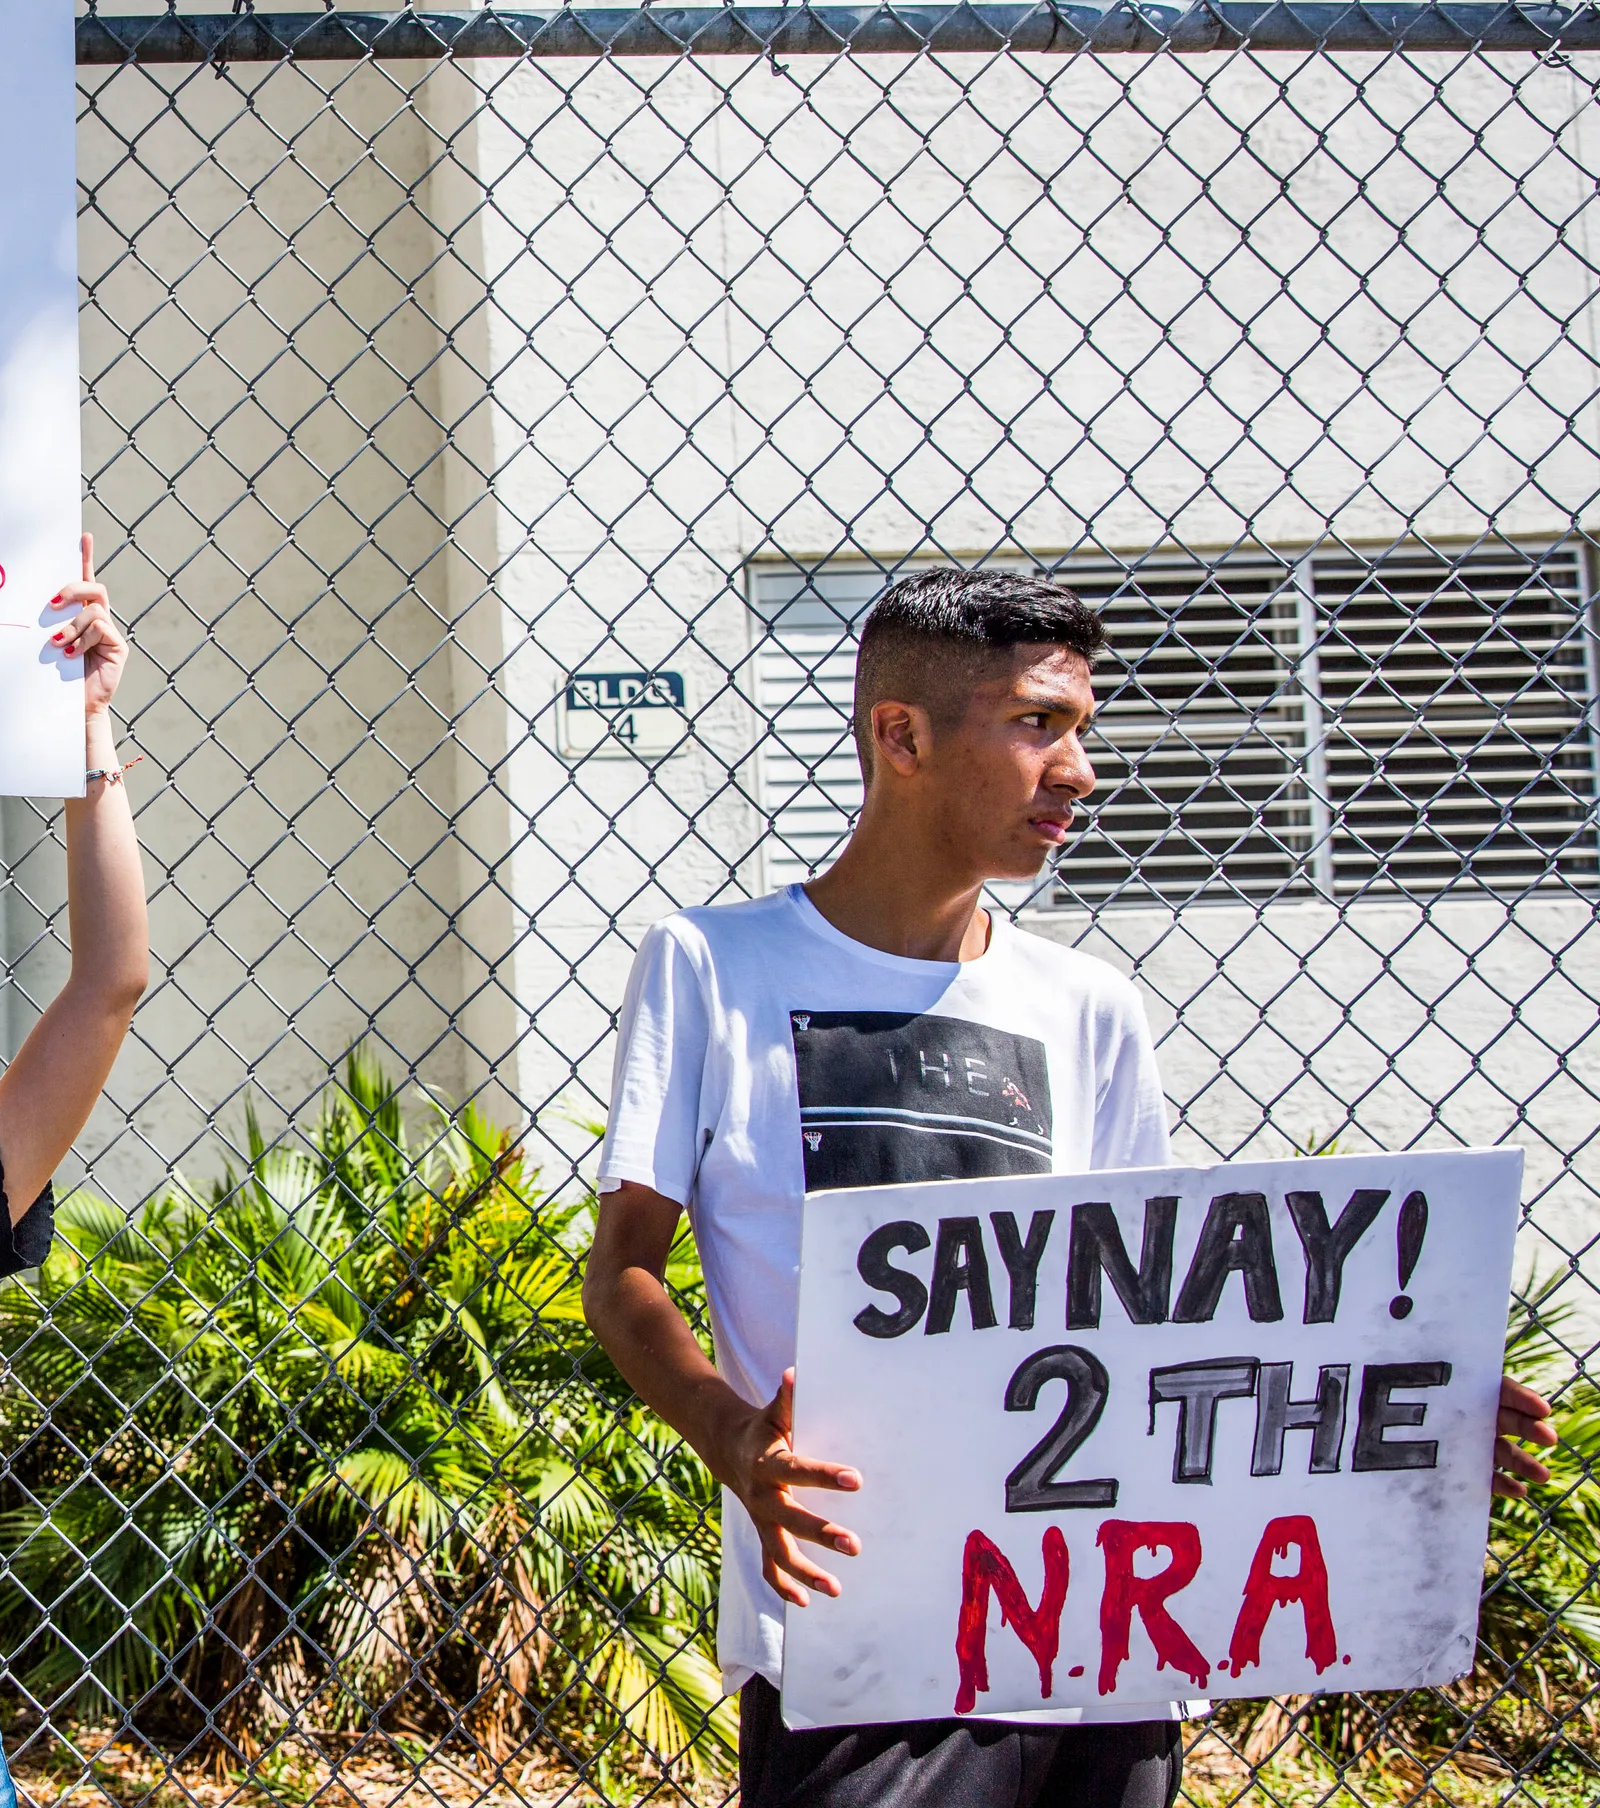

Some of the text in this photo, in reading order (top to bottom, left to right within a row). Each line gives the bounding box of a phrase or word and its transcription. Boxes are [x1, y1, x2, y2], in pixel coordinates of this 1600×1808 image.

[616, 713, 639, 744] 4
[1003, 1343, 1452, 1514] 2 THE
[953, 1514, 1353, 1717] N.R.A.
